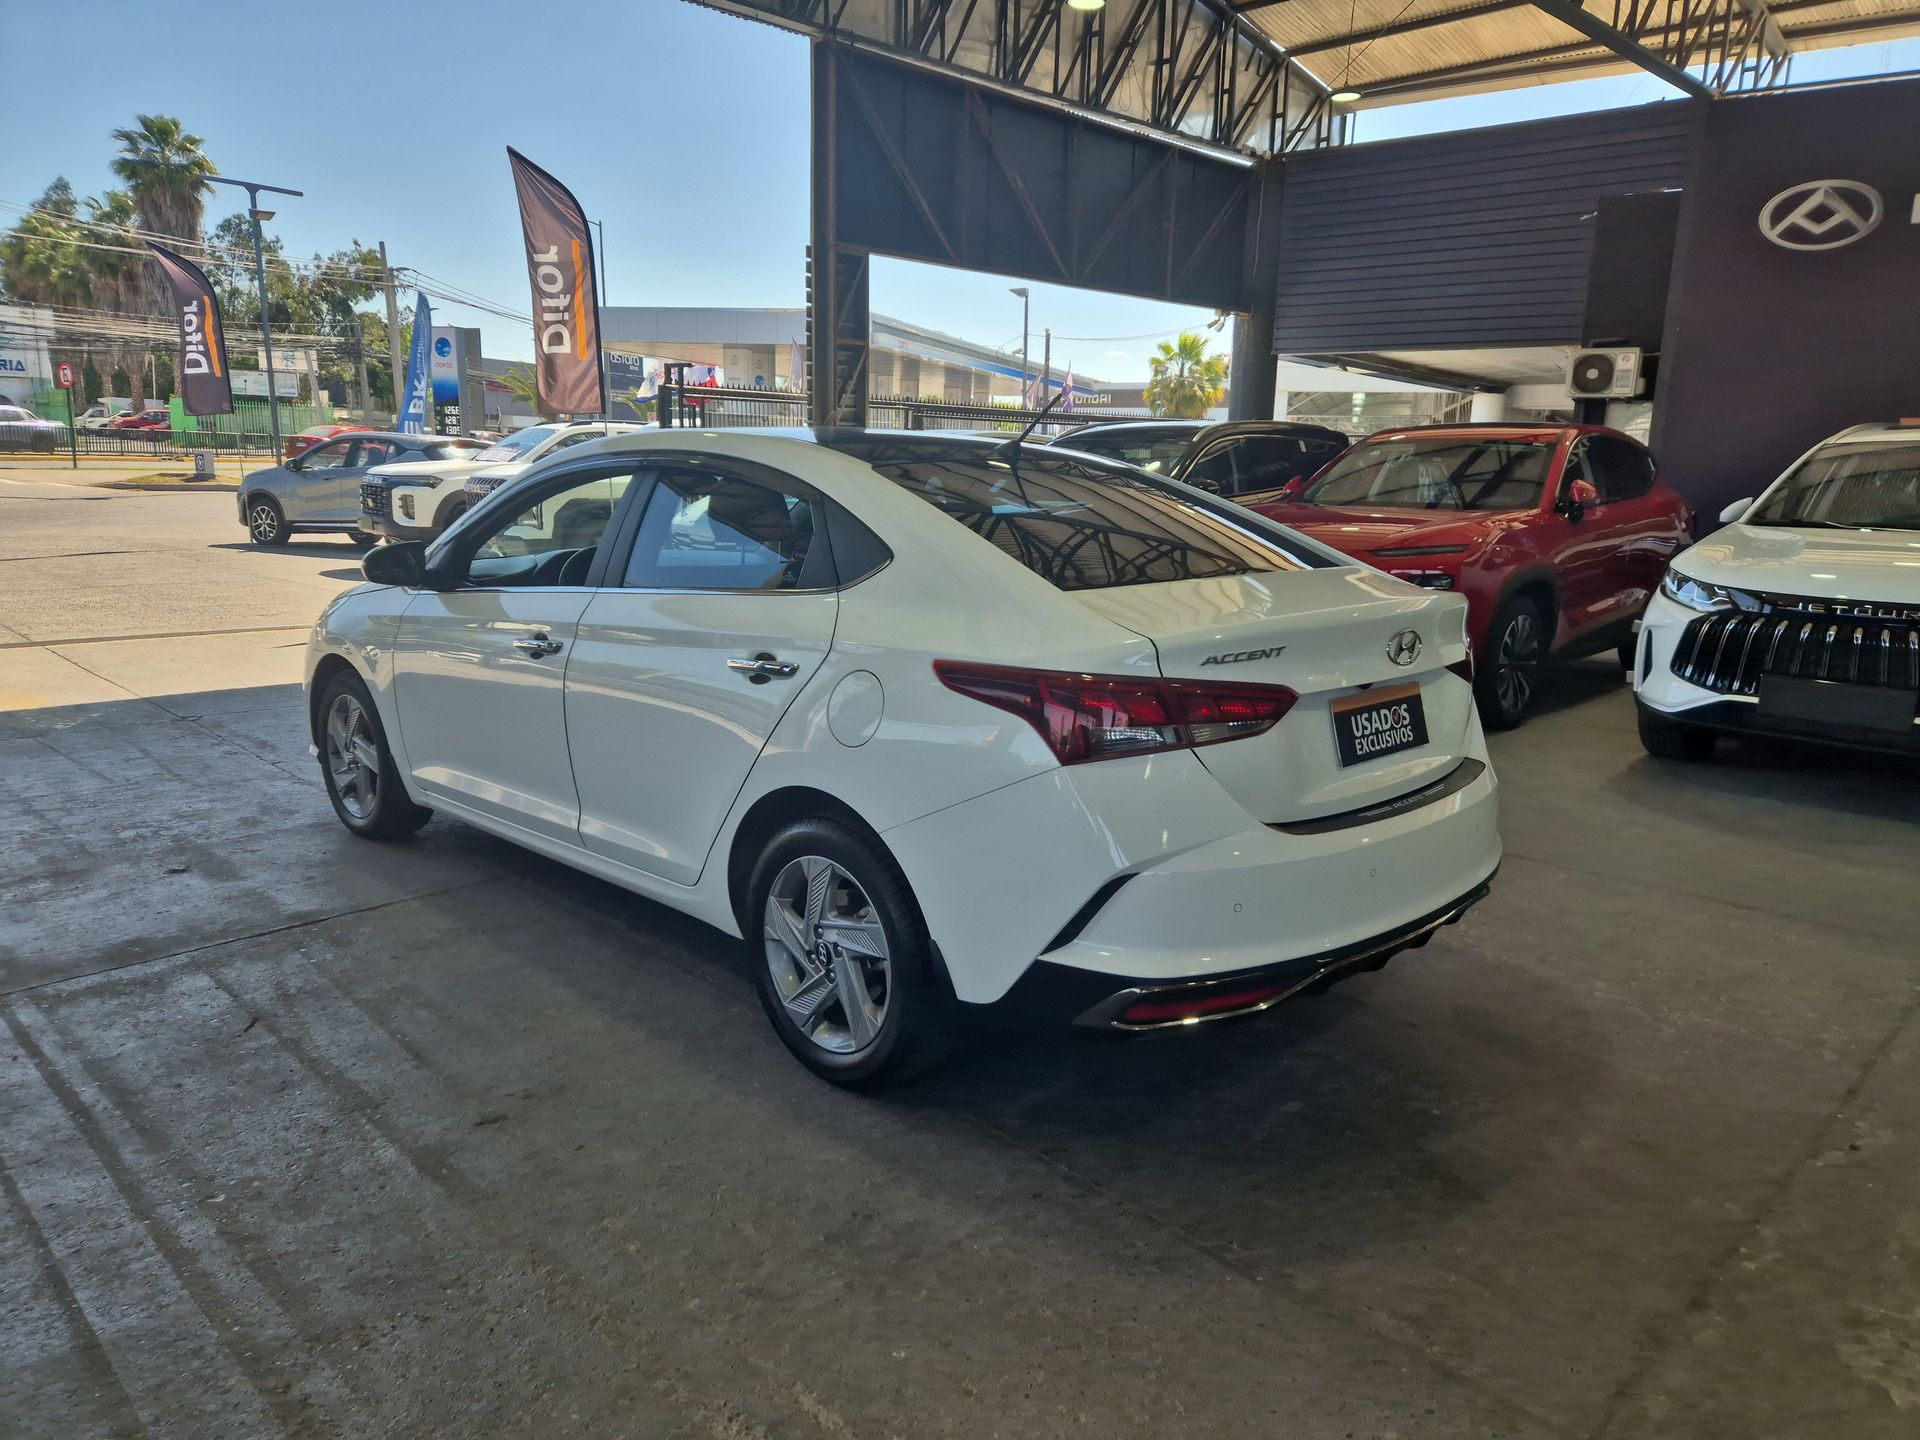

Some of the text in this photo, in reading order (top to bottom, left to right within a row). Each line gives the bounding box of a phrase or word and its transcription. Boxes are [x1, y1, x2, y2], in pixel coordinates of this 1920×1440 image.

[1060, 393, 1112, 404] UNDAI
[1200, 646, 1286, 667] ACCENT
[1351, 703, 1410, 738] USADOS
[1355, 725, 1414, 756] EXCLUSIVOS
